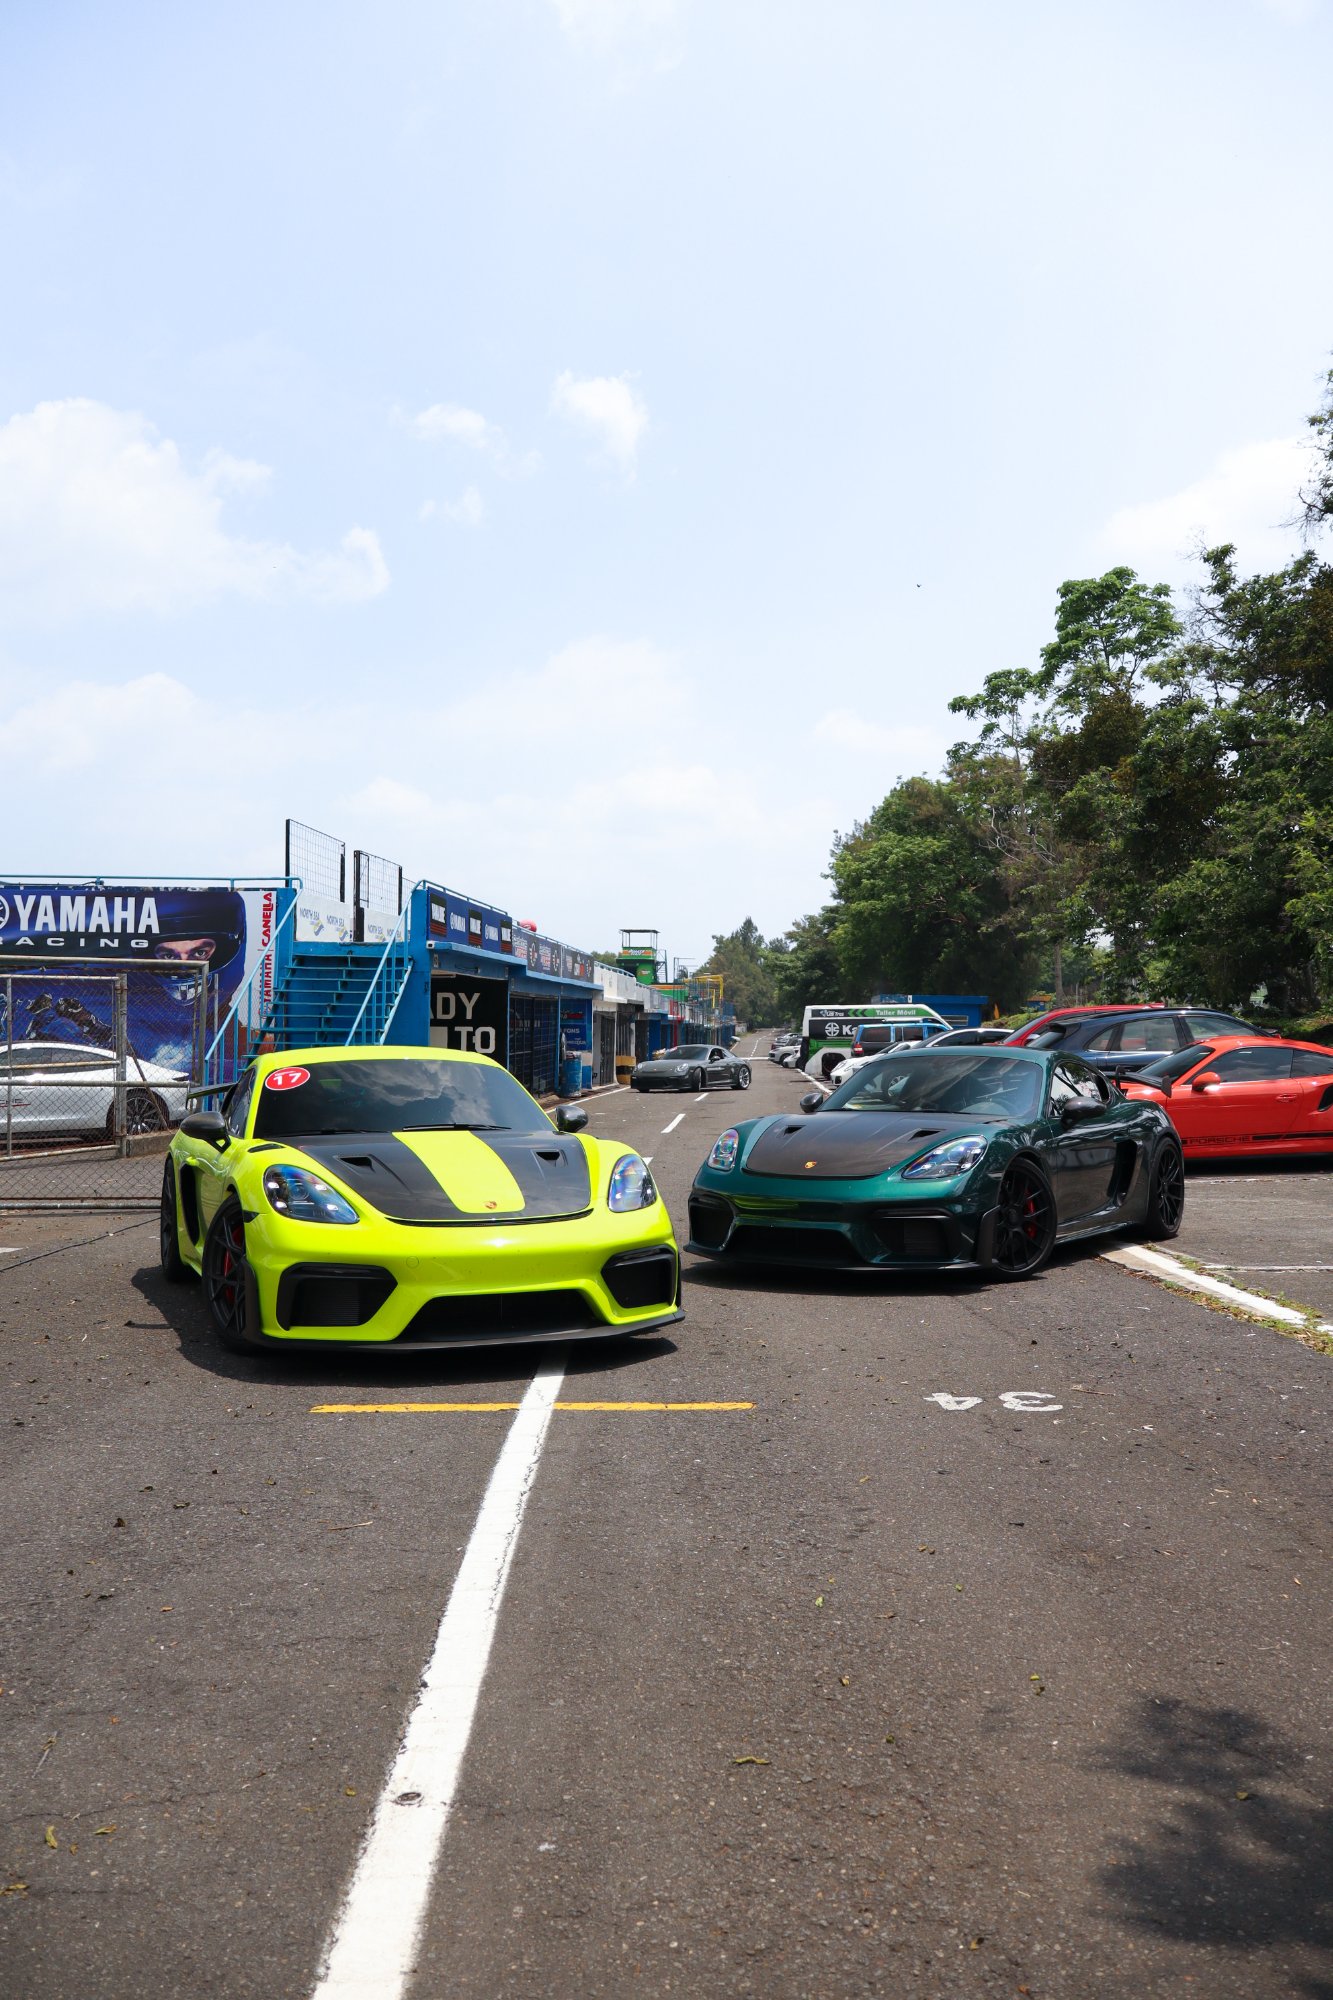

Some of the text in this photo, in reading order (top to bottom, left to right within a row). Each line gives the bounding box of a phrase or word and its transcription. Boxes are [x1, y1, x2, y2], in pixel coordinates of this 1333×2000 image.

[13, 894, 160, 934] YAMAHA
[261, 892, 273, 947] CANELLA
[326, 914, 338, 926] NORTH
[454, 1026, 496, 1054] TO
[273, 1072, 302, 1086] 17
[1189, 1135, 1251, 1146] PORSCHE
